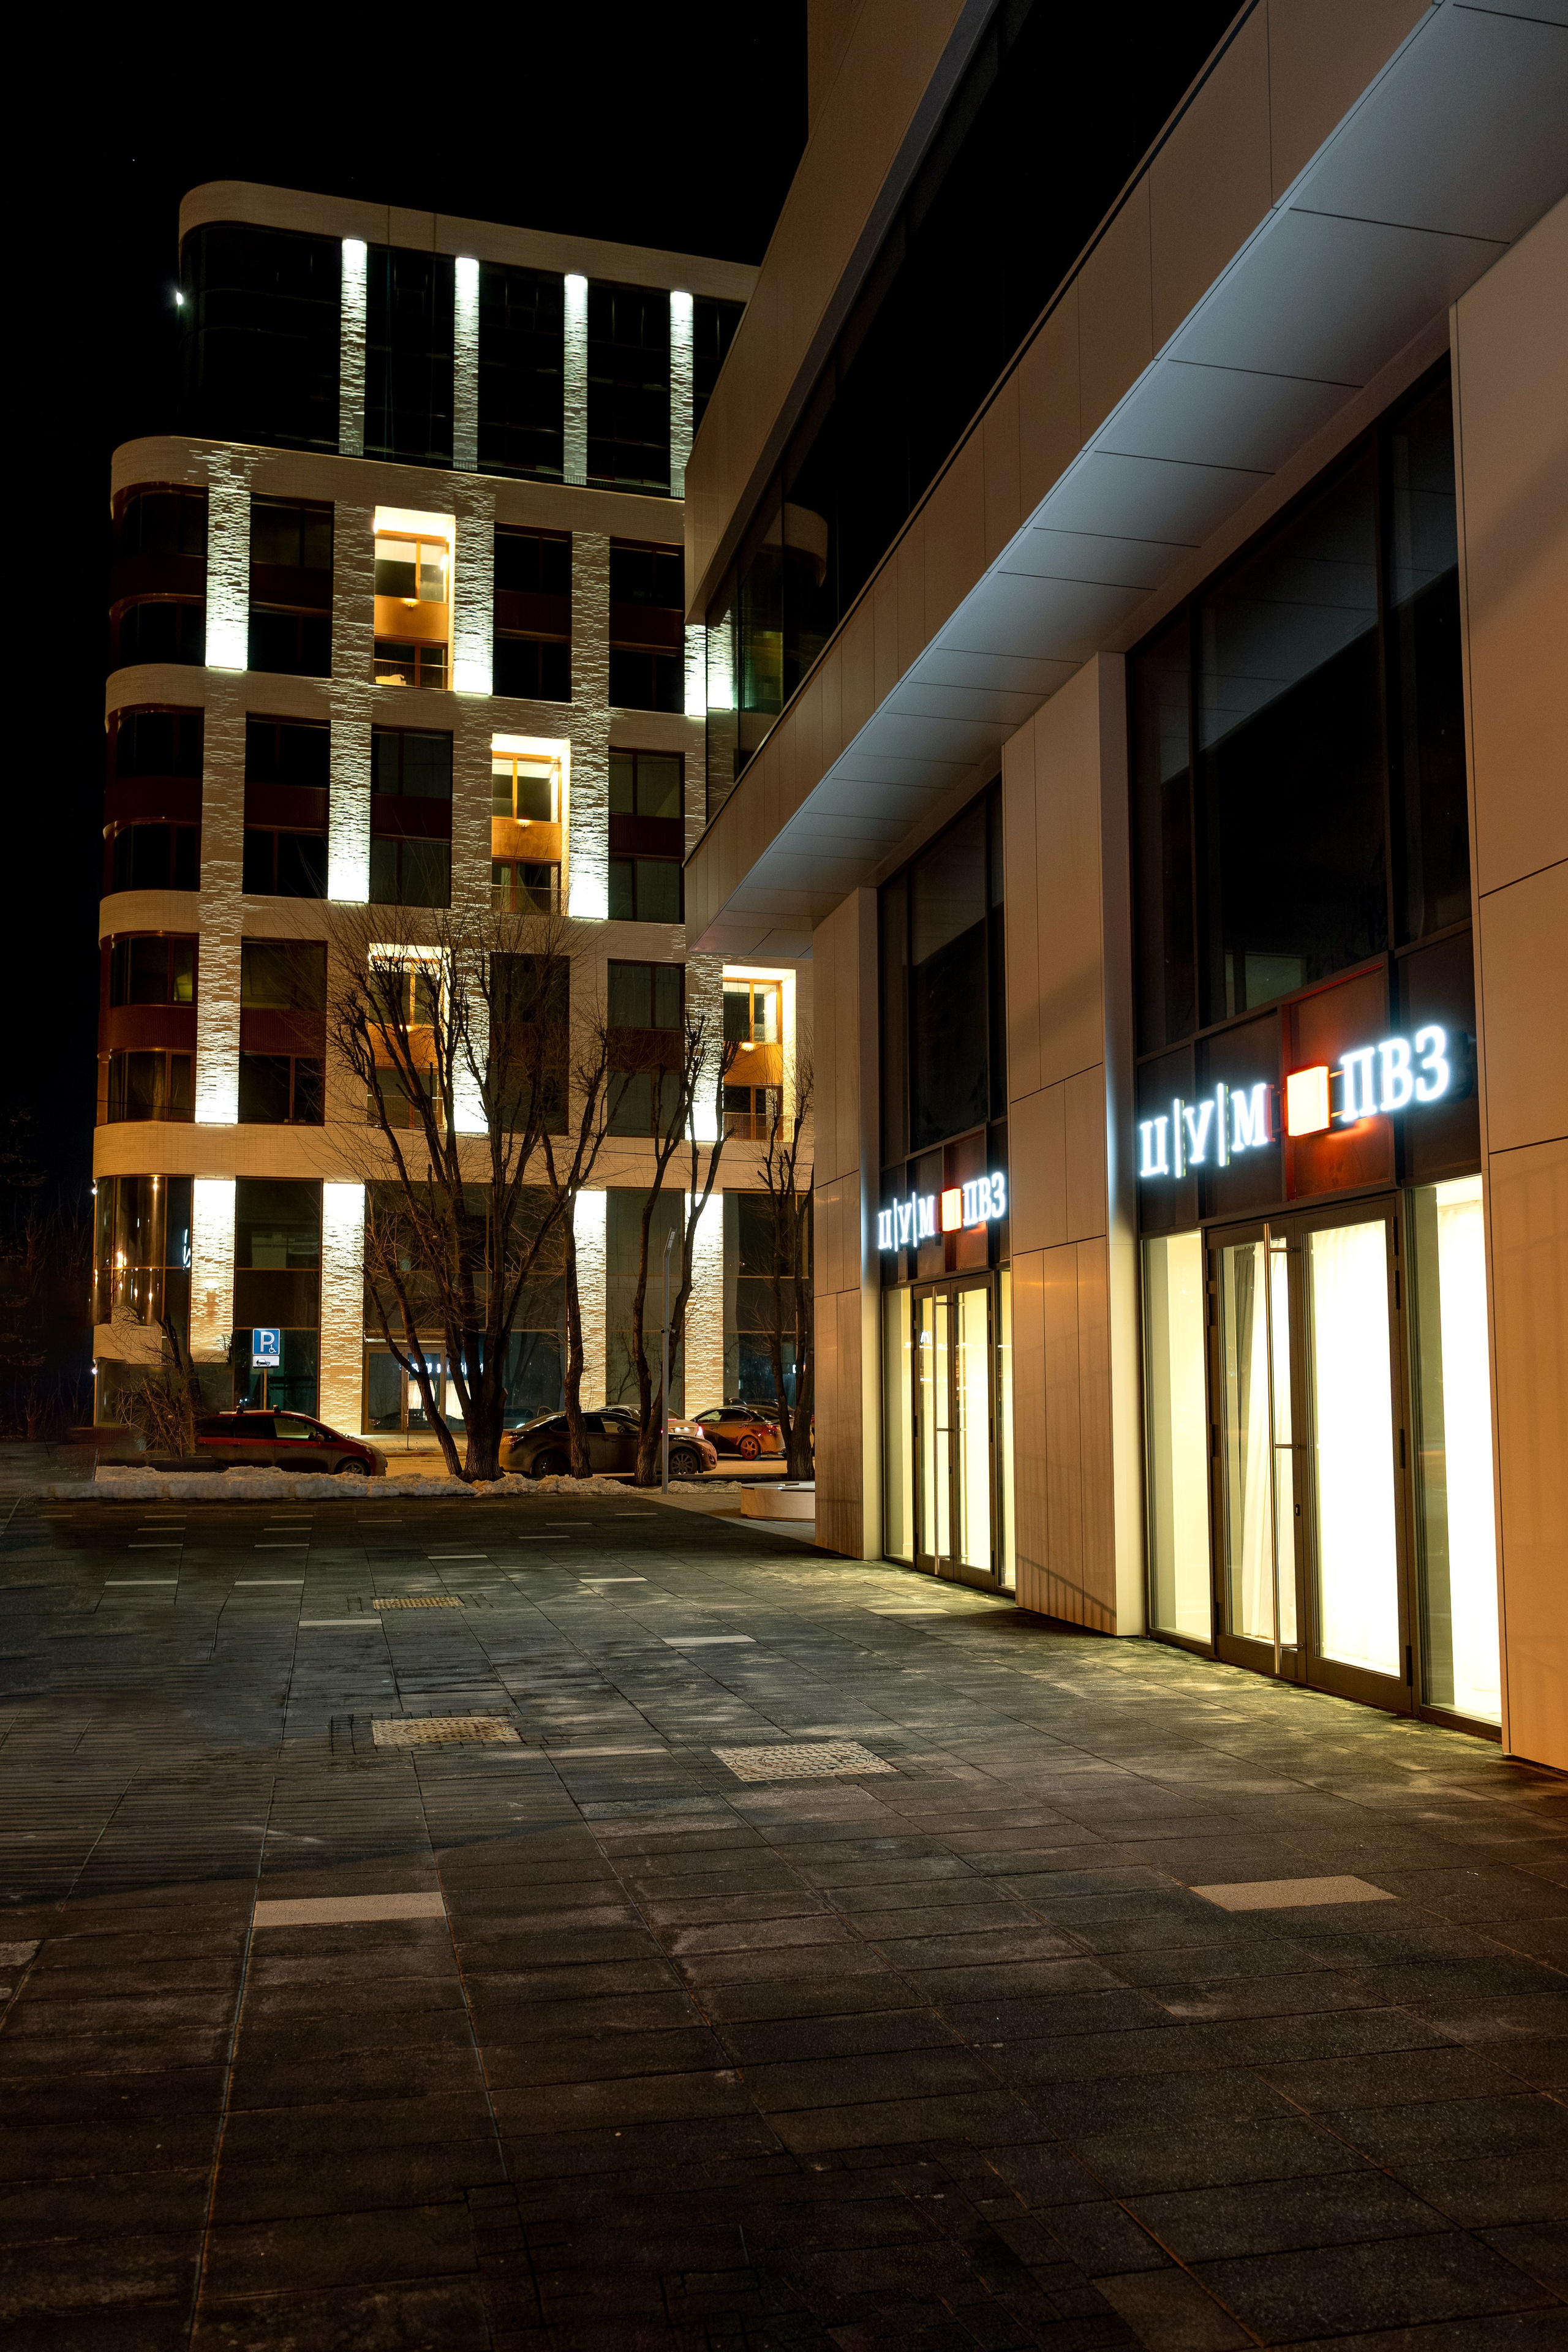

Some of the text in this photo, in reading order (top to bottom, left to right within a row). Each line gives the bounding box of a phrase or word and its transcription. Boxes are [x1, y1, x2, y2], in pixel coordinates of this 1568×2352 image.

[1340, 1026, 1449, 1122] ПВЗ
[963, 1172, 1006, 1226] ПВЗ
[260, 1332, 275, 1352] P
